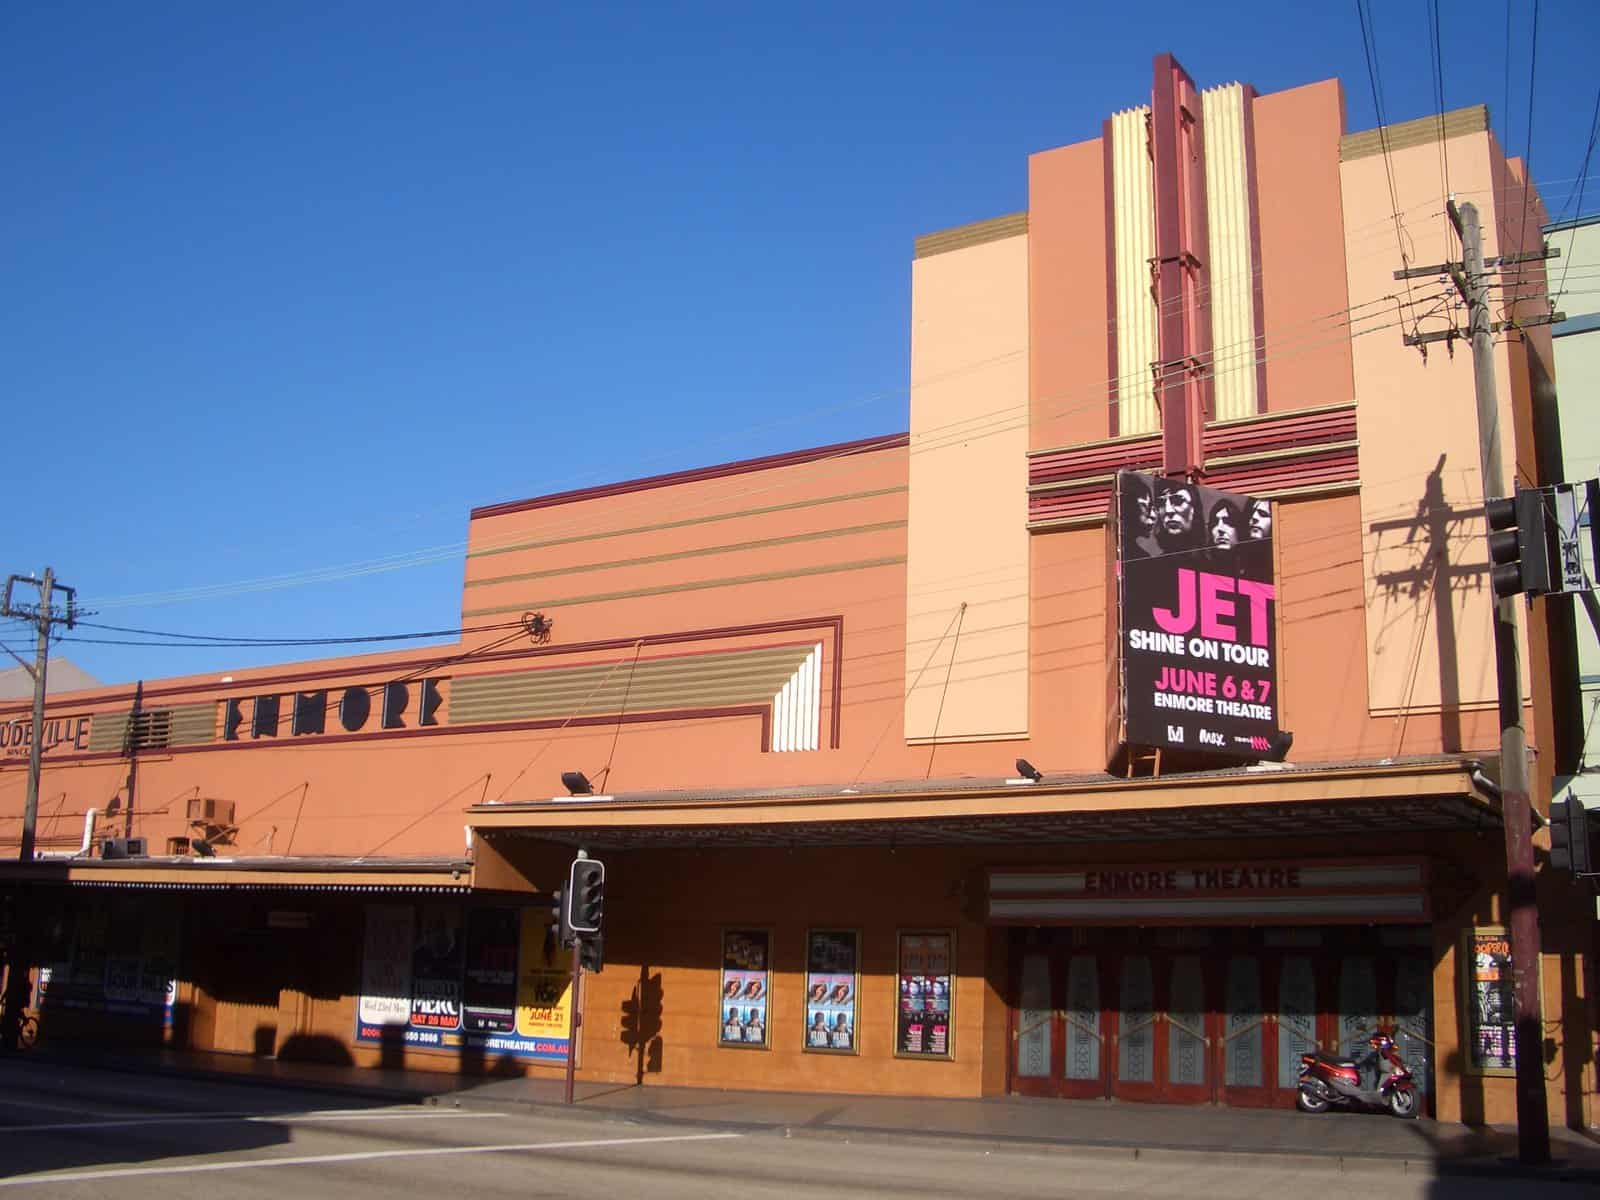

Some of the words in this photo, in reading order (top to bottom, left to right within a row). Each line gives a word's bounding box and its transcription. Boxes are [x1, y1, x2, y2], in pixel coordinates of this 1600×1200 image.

[1152, 568, 1275, 647] JET
[1130, 629, 1184, 655] SHINE
[1190, 638, 1218, 661] ON
[1222, 642, 1269, 668] TOUR
[1155, 667, 1217, 698] JUNE
[1222, 675, 1237, 699] 6
[1240, 679, 1255, 701] &
[1256, 680, 1271, 703] 7
[224, 678, 444, 741] ENMORE
[1154, 692, 1213, 714] ENMORE
[1217, 700, 1272, 721] THEATRE
[1085, 871, 1177, 892] ENMORE
[1191, 867, 1301, 890] THEATRE
[440, 1015, 458, 1027] MAY
[530, 1011, 552, 1021] JUNE
